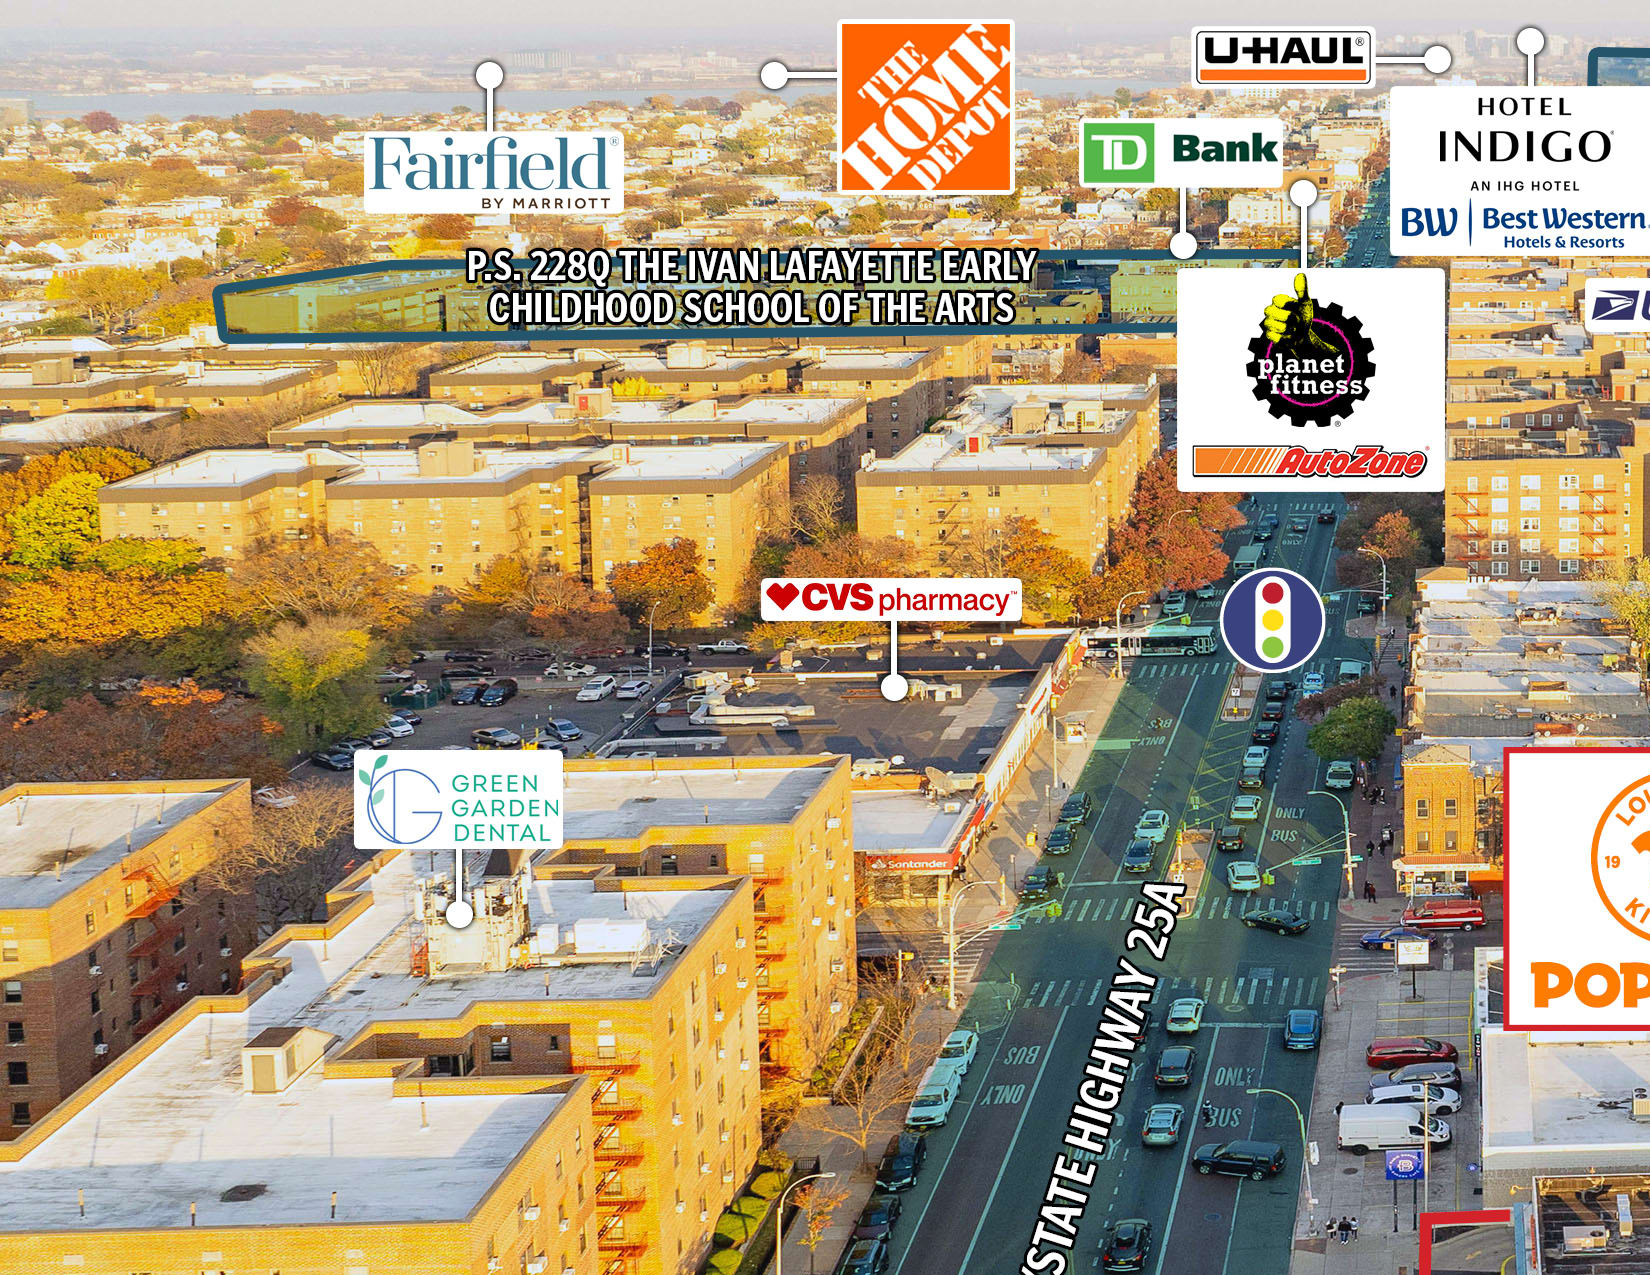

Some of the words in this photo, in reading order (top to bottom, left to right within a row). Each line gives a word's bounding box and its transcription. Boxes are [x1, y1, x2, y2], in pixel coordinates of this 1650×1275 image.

[1274, 807, 1306, 820] ONLY
[1270, 829, 1299, 842] BUS
[887, 859, 949, 869] Santander
[1003, 1045, 1042, 1065] BUS
[1214, 1066, 1257, 1087] ONLY
[981, 1083, 1026, 1106] ONLY
